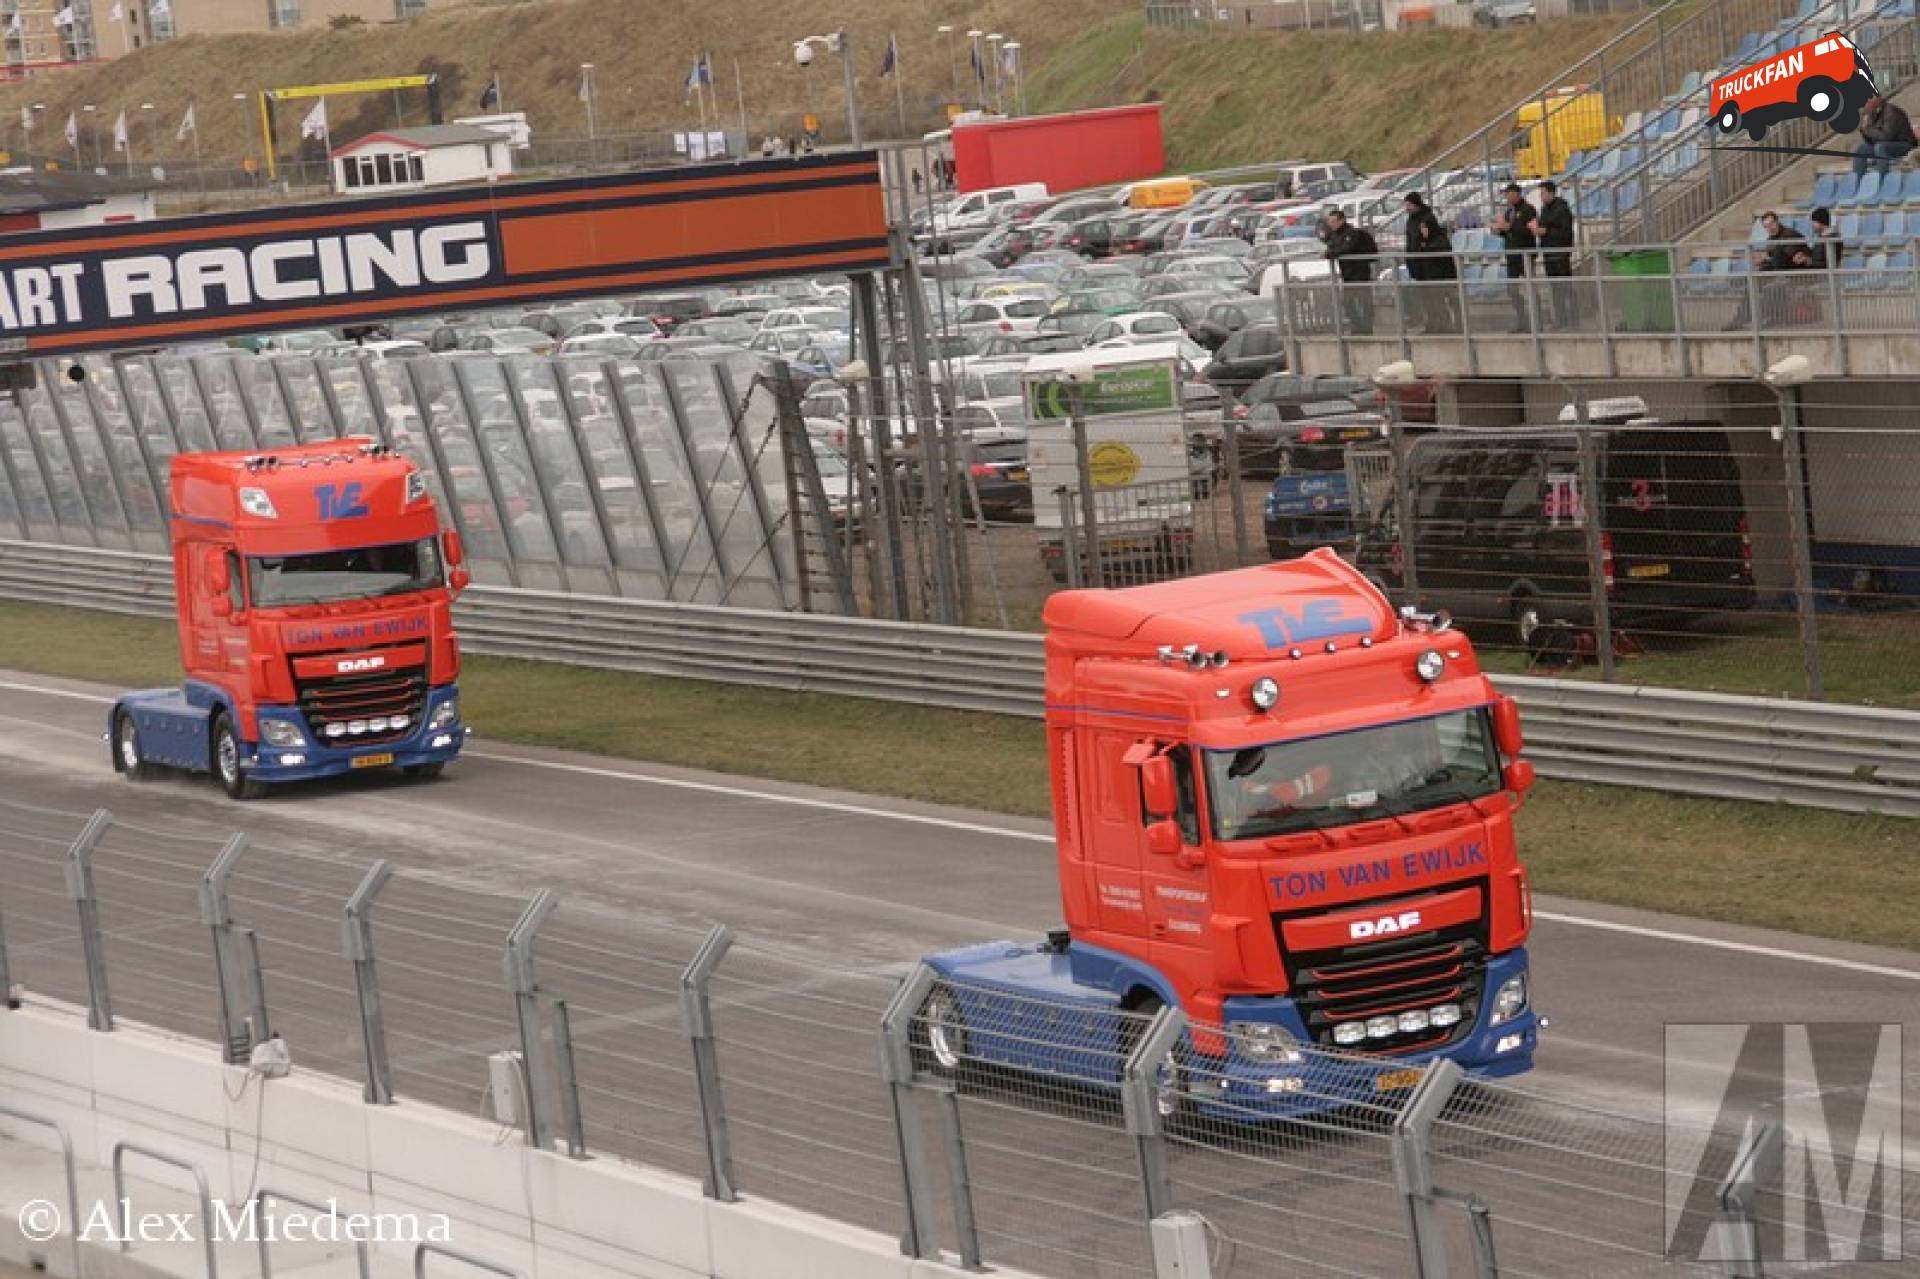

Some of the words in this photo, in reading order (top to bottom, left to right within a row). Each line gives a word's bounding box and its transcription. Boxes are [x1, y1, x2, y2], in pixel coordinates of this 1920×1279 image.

[103, 221, 489, 318] RACING
[338, 657, 385, 673] DAF
[1270, 871, 1327, 898] TON
[1339, 859, 1391, 888] VAN
[1403, 842, 1486, 877] EWIJK
[1350, 911, 1421, 939] DAF
